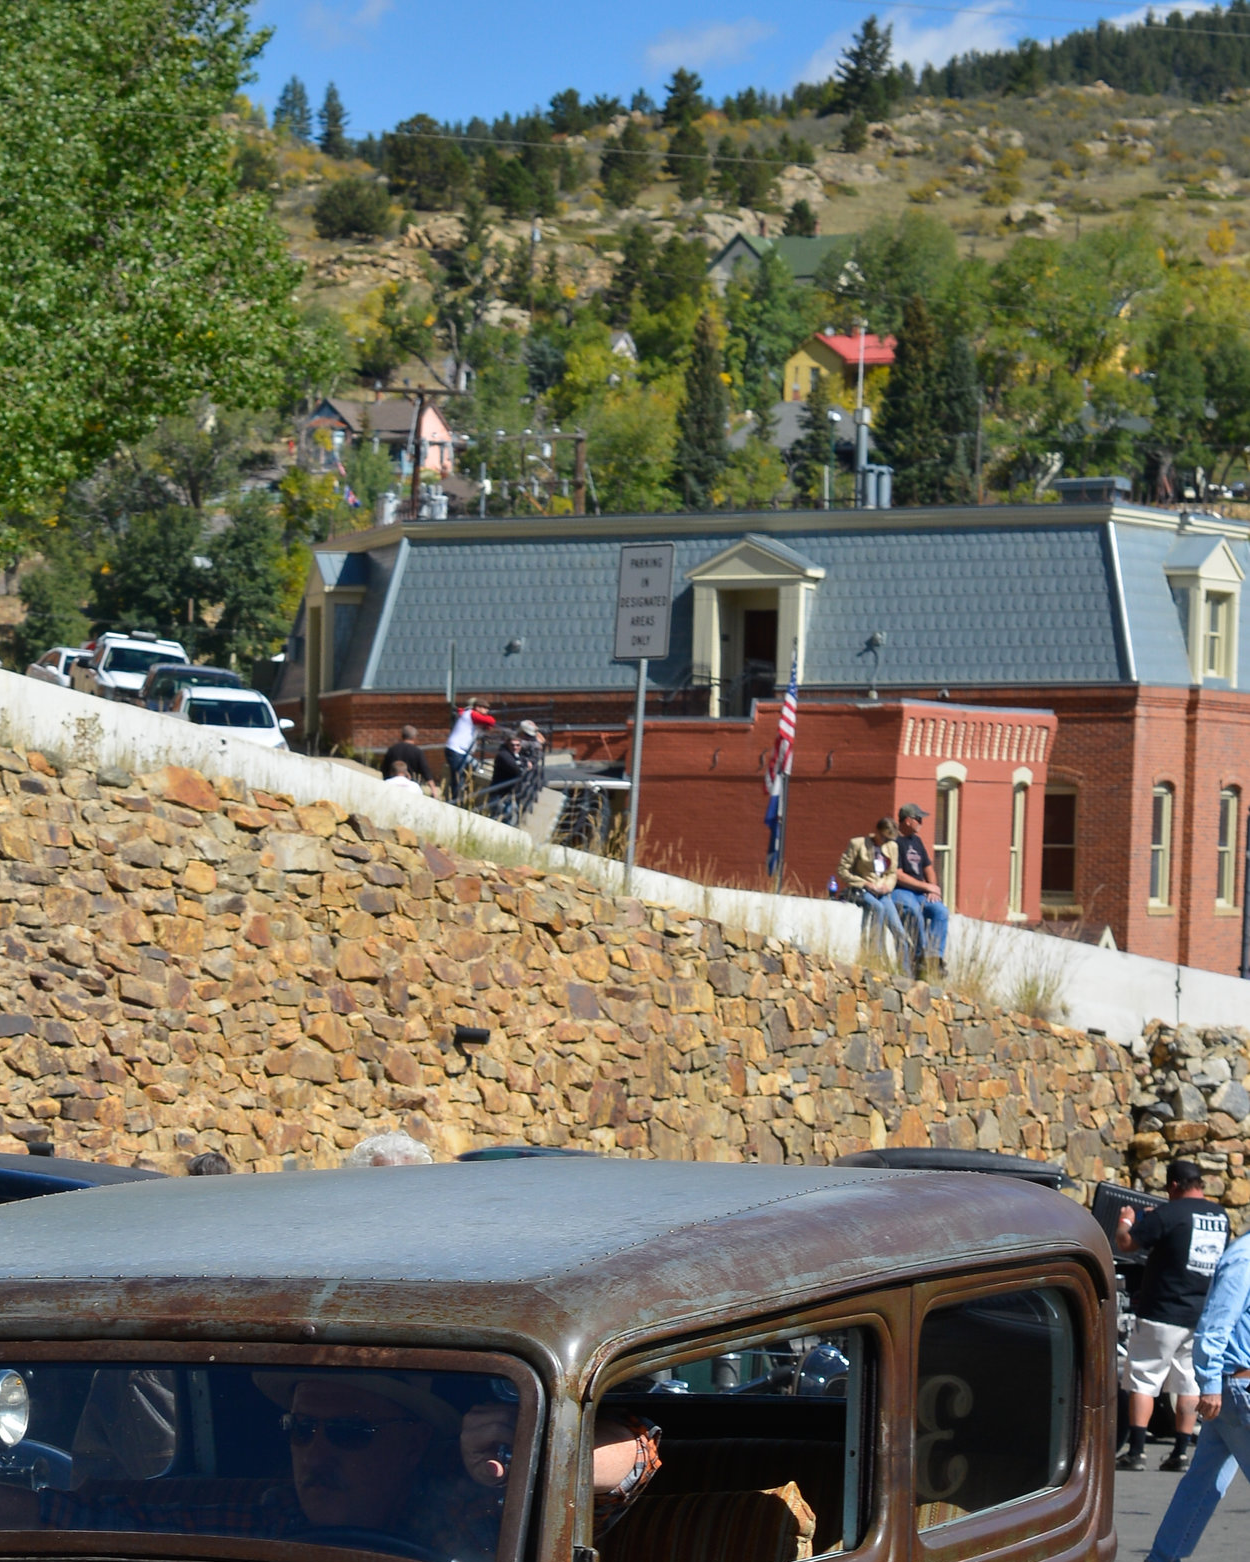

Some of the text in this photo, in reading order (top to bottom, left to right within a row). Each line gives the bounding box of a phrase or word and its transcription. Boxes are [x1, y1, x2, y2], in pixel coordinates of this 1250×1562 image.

[630, 557, 663, 569] PARKING
[640, 577, 650, 588] IN
[619, 595, 667, 608] DESIGNATED
[630, 615, 655, 627] AREAS
[631, 635, 651, 647] ONLY
